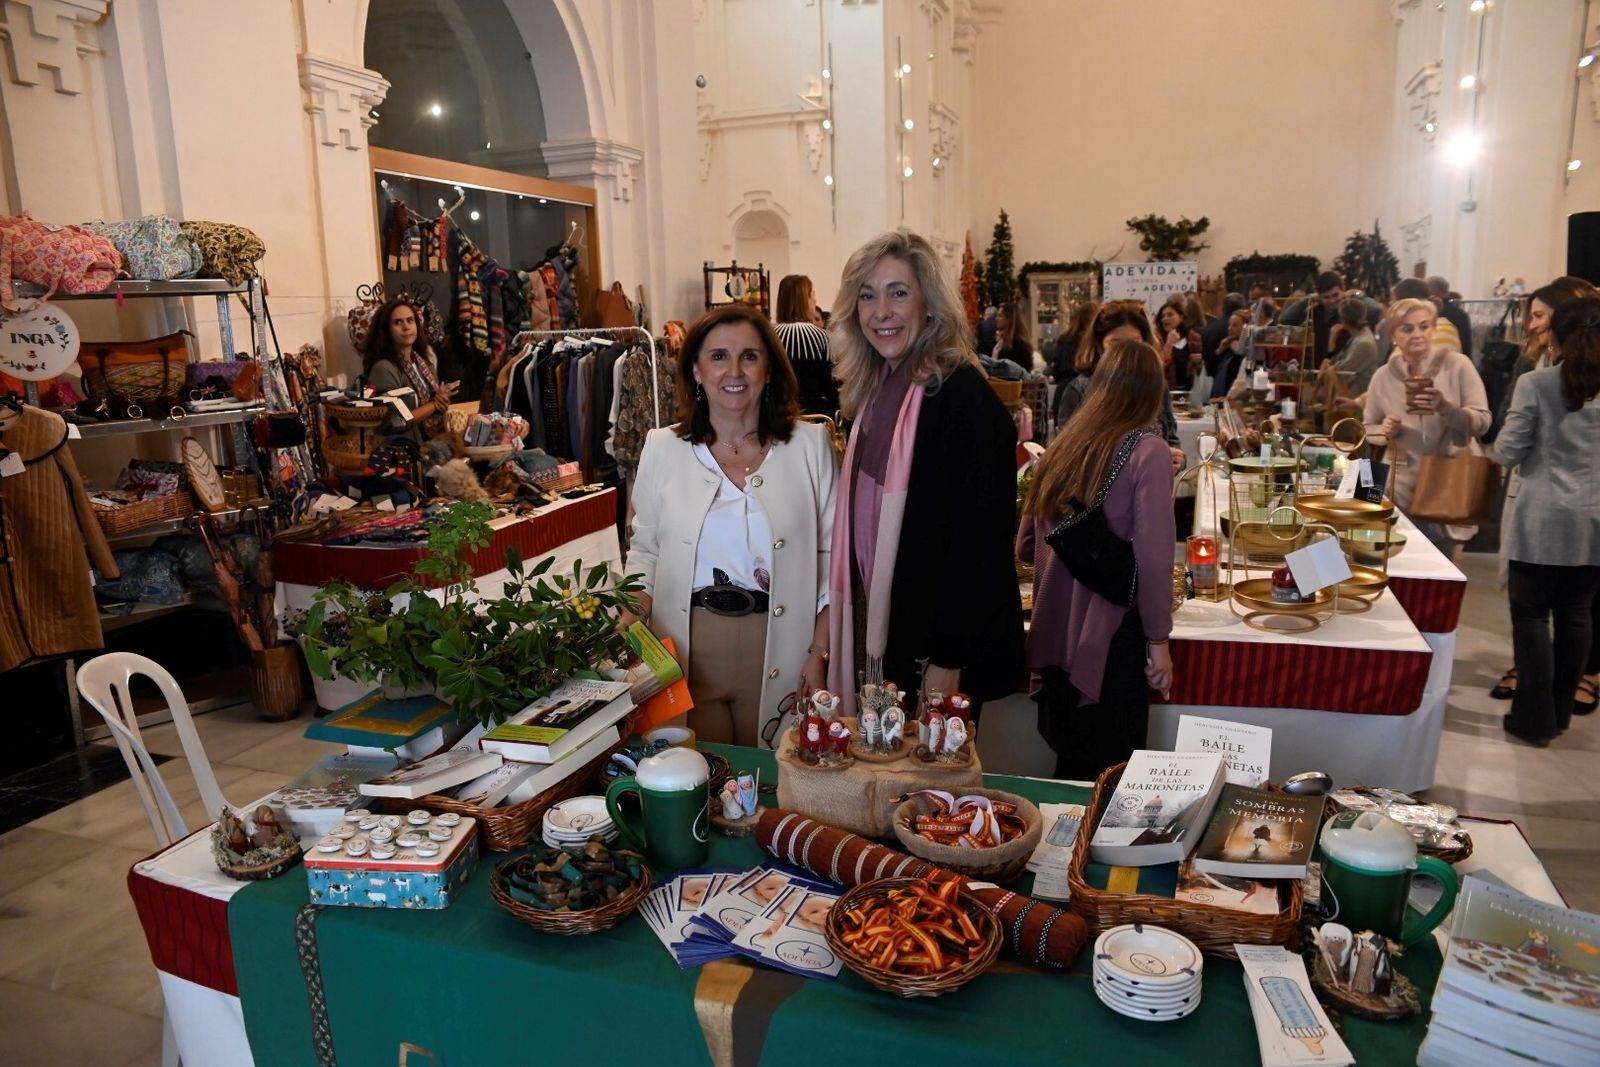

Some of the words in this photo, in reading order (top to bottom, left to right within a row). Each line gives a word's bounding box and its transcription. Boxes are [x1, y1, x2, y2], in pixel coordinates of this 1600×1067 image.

[1105, 266, 1177, 277] ADEVIDA
[1144, 284, 1195, 292] ADEVIDA
[9, 332, 55, 346] INGA
[1200, 738, 1246, 753] BAILE
[1149, 768, 1193, 777] BAILE
[1223, 760, 1263, 774] NETAS
[1124, 782, 1205, 792] MARIONETAS
[1234, 799, 1305, 813] SOMBRAS
[1229, 808, 1304, 823] MEMORIA
[781, 952, 822, 967] ADEVIDA
